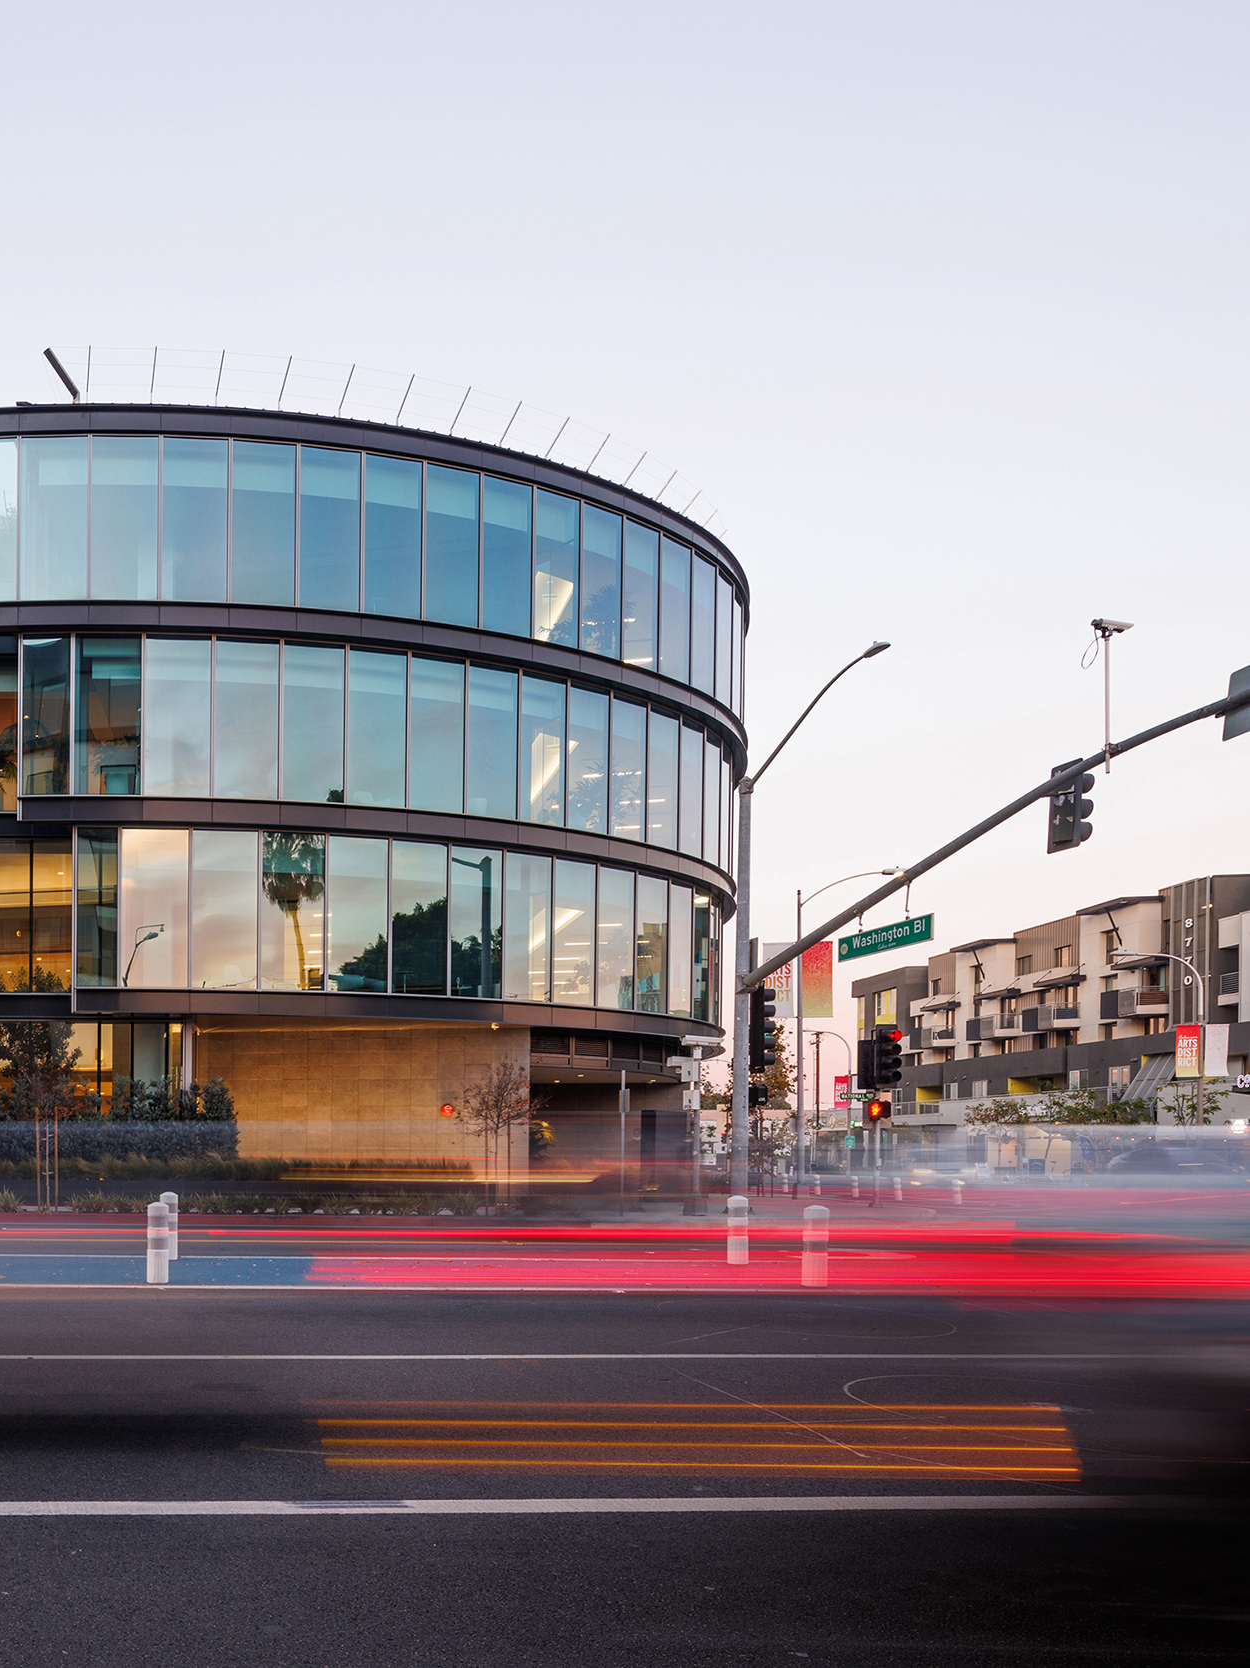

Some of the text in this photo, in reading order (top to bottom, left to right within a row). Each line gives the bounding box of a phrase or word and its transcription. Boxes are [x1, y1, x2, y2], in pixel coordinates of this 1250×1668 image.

[852, 925, 909, 949] Washington
[914, 918, 926, 934] Bl
[1184, 918, 1194, 986] 8770
[765, 975, 791, 989] DIST
[1178, 1039, 1197, 1048] ARTS
[1178, 1047, 1197, 1057] DIST
[1177, 1057, 1197, 1067] RICT
